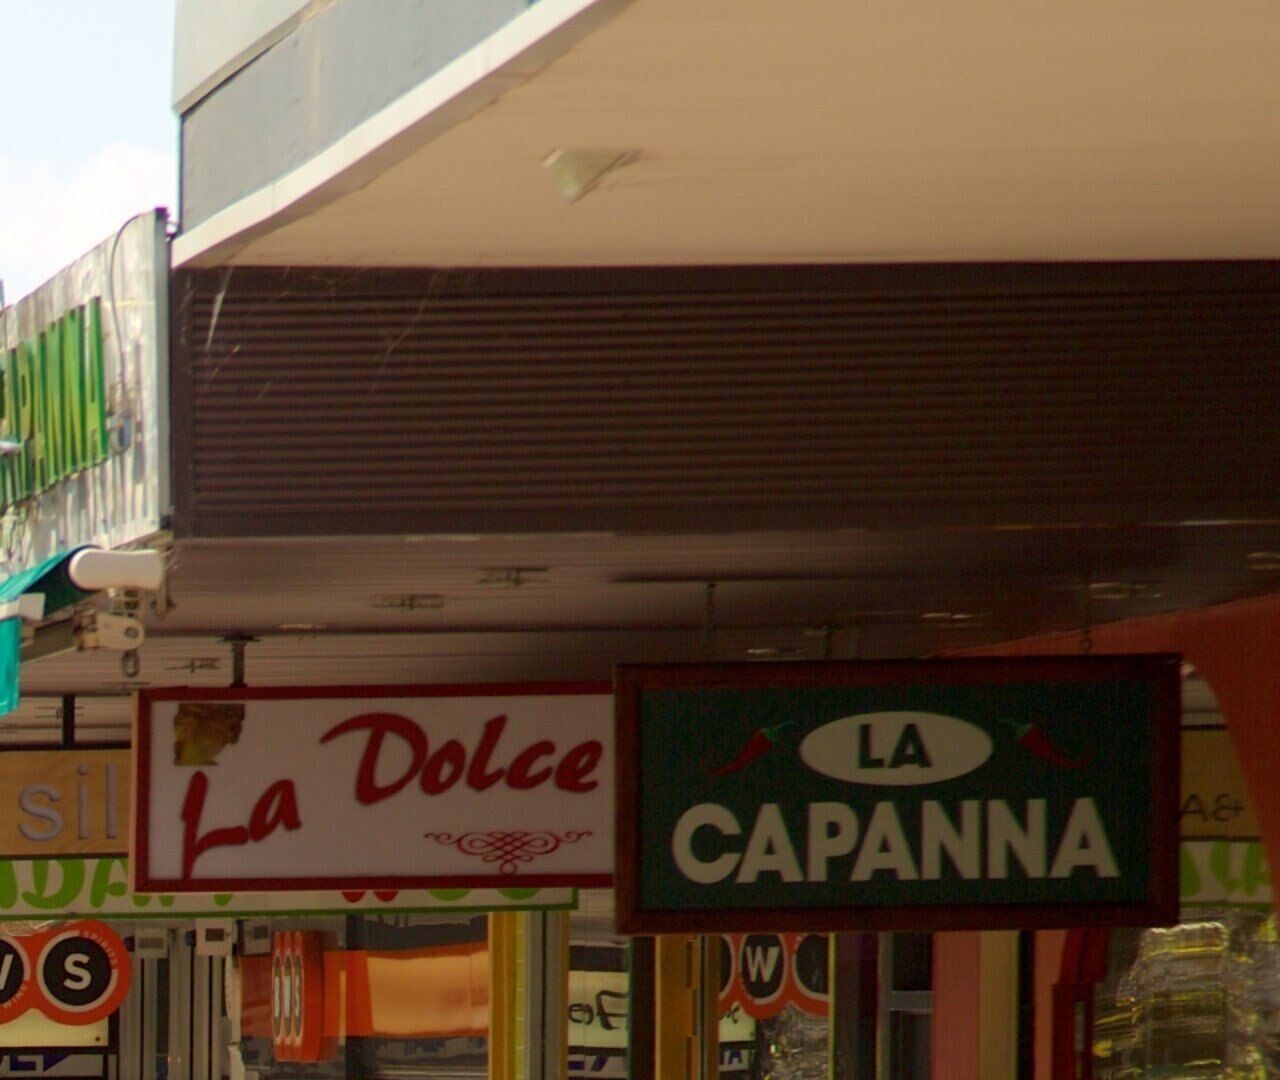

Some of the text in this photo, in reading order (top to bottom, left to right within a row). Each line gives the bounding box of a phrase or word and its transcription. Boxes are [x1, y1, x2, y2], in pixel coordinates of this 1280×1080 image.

[858, 720, 934, 770] LA
[180, 711, 603, 880] La Dolce
[671, 797, 1122, 886] CAPANNA
[82, 930, 119, 971] SPIRITS
